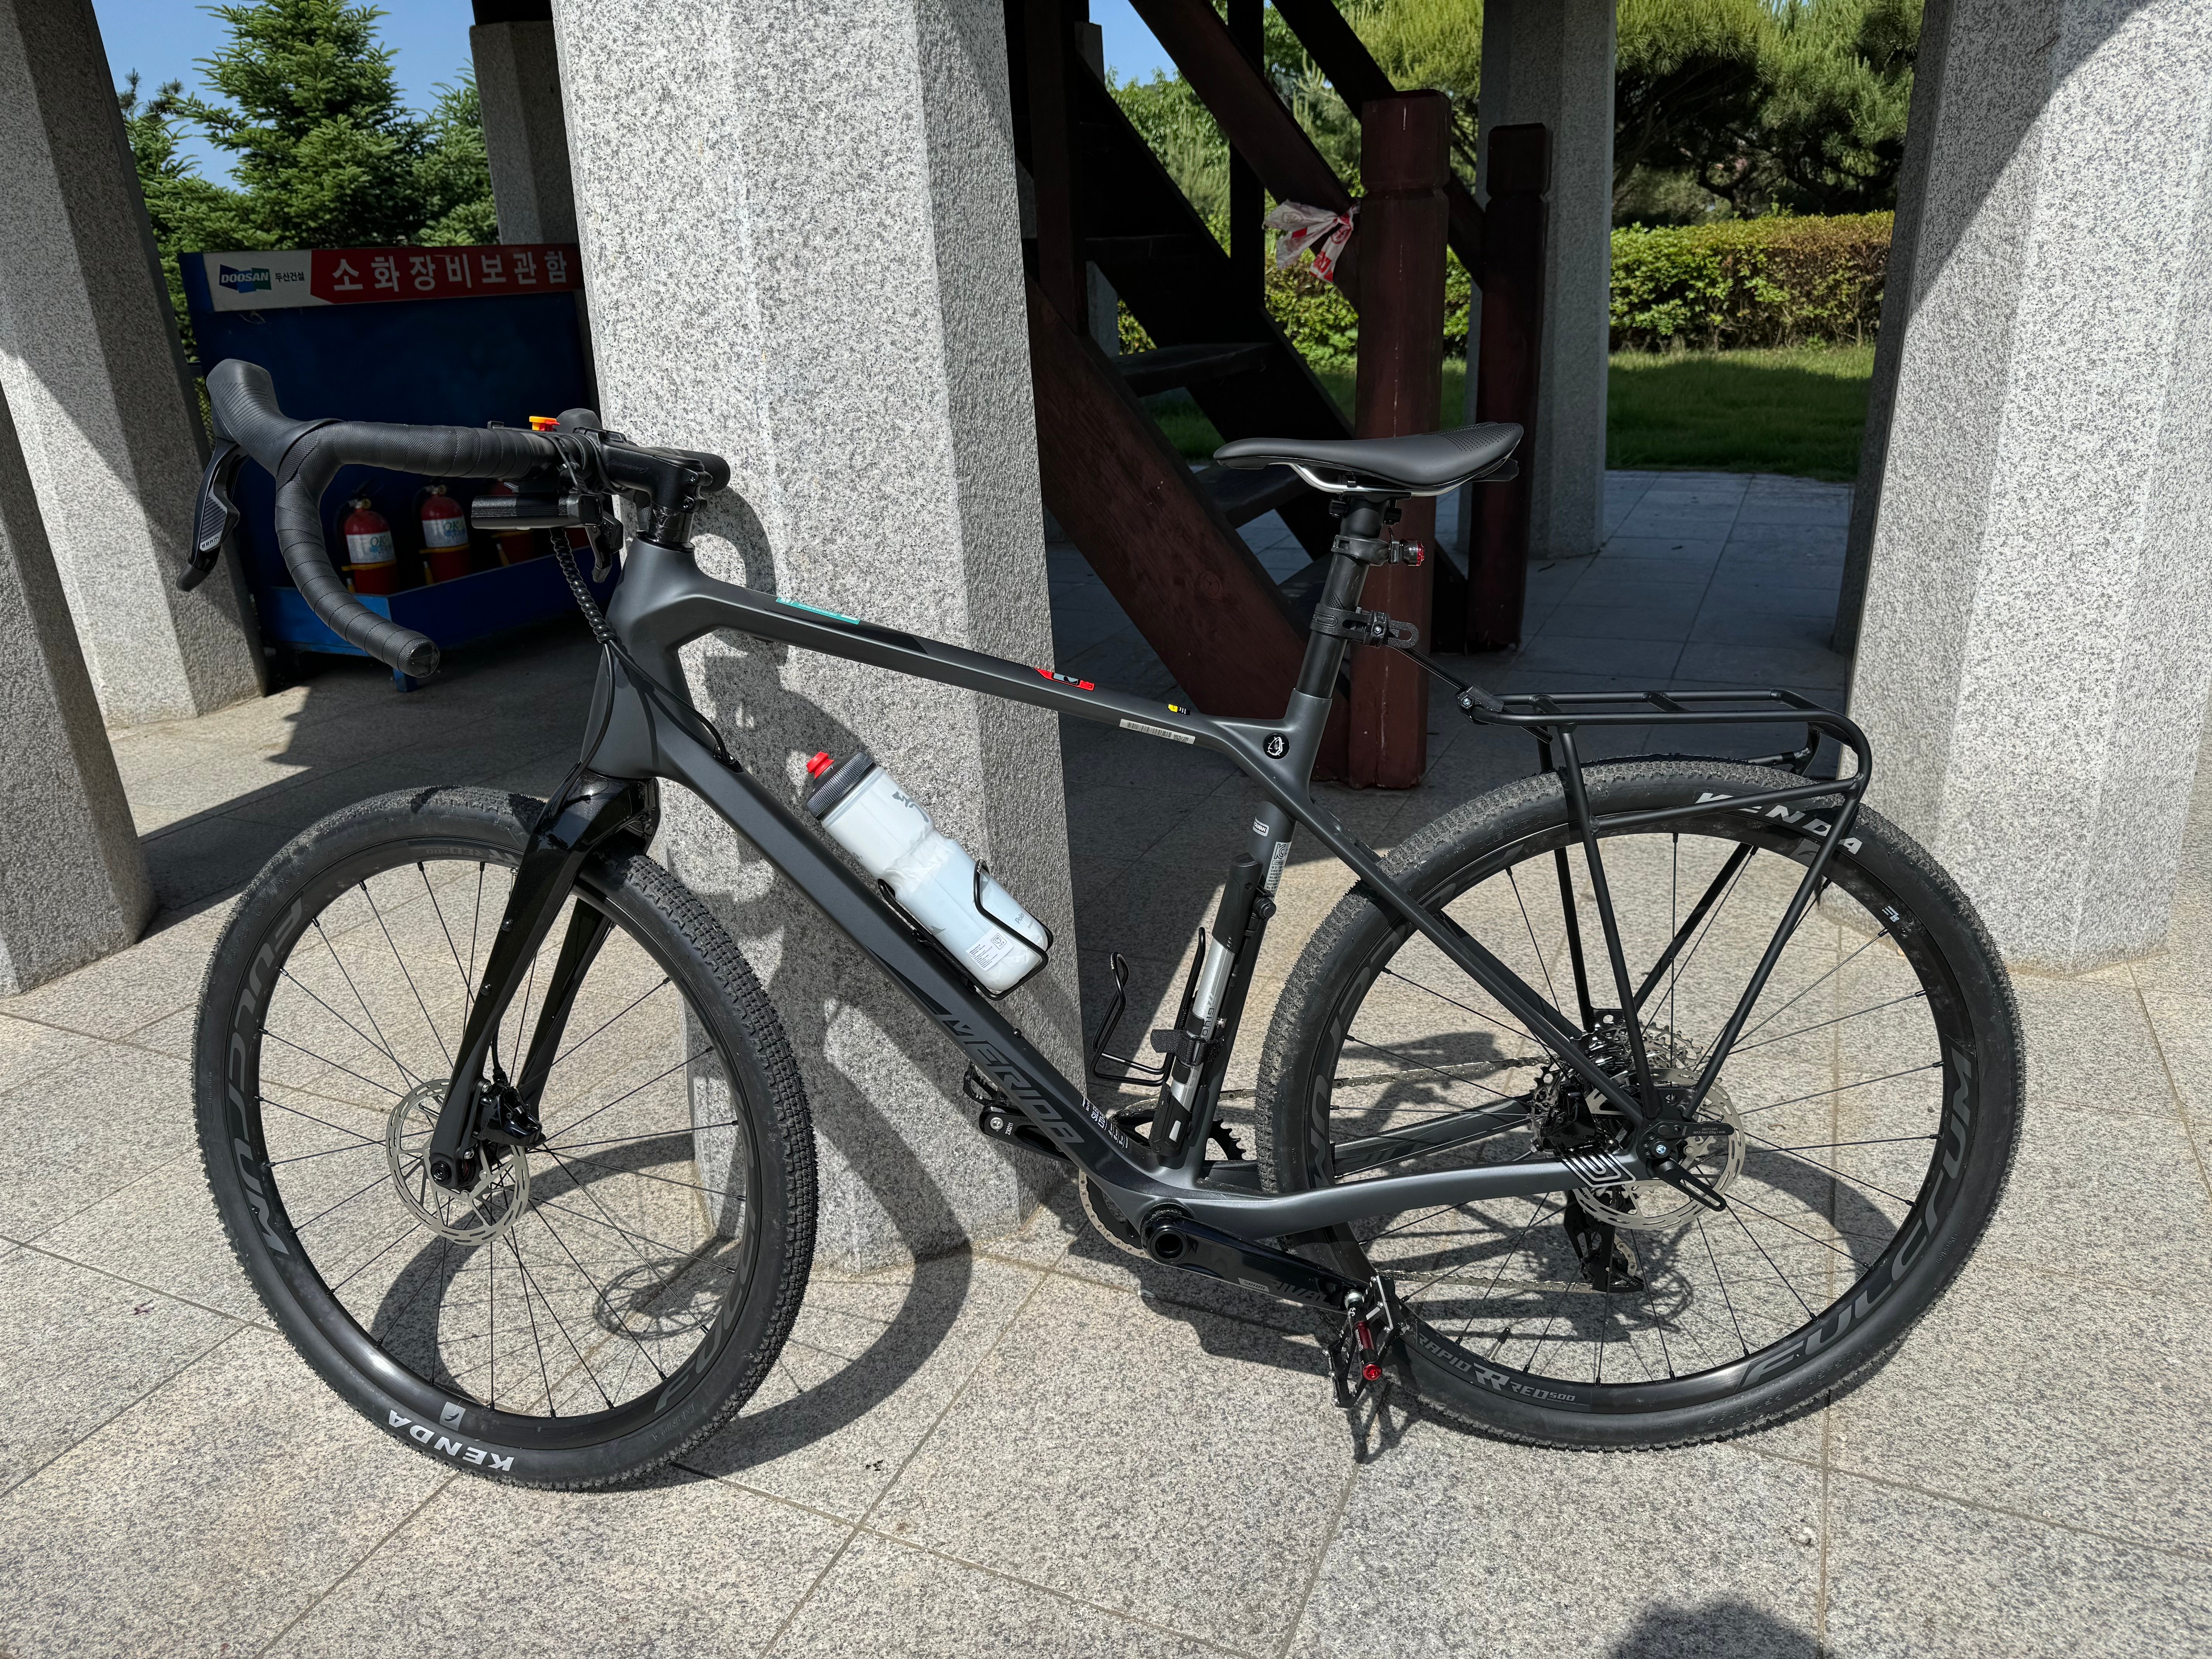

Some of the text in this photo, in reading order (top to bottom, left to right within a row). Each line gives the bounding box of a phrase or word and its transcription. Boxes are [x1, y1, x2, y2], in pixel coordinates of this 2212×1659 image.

[221, 272, 268, 283] DOOSAN
[275, 271, 305, 282] 두산건설
[201, 536, 220, 548] SRAM
[228, 896, 303, 1255] FULCRUM
[935, 1015, 1084, 1145] MERIDA
[1738, 1046, 1972, 1389] FULCRUM
[1244, 1281, 1266, 1290] SRAM
[1418, 1333, 1472, 1373] RAPID
[388, 1409, 514, 1472] KENDA
